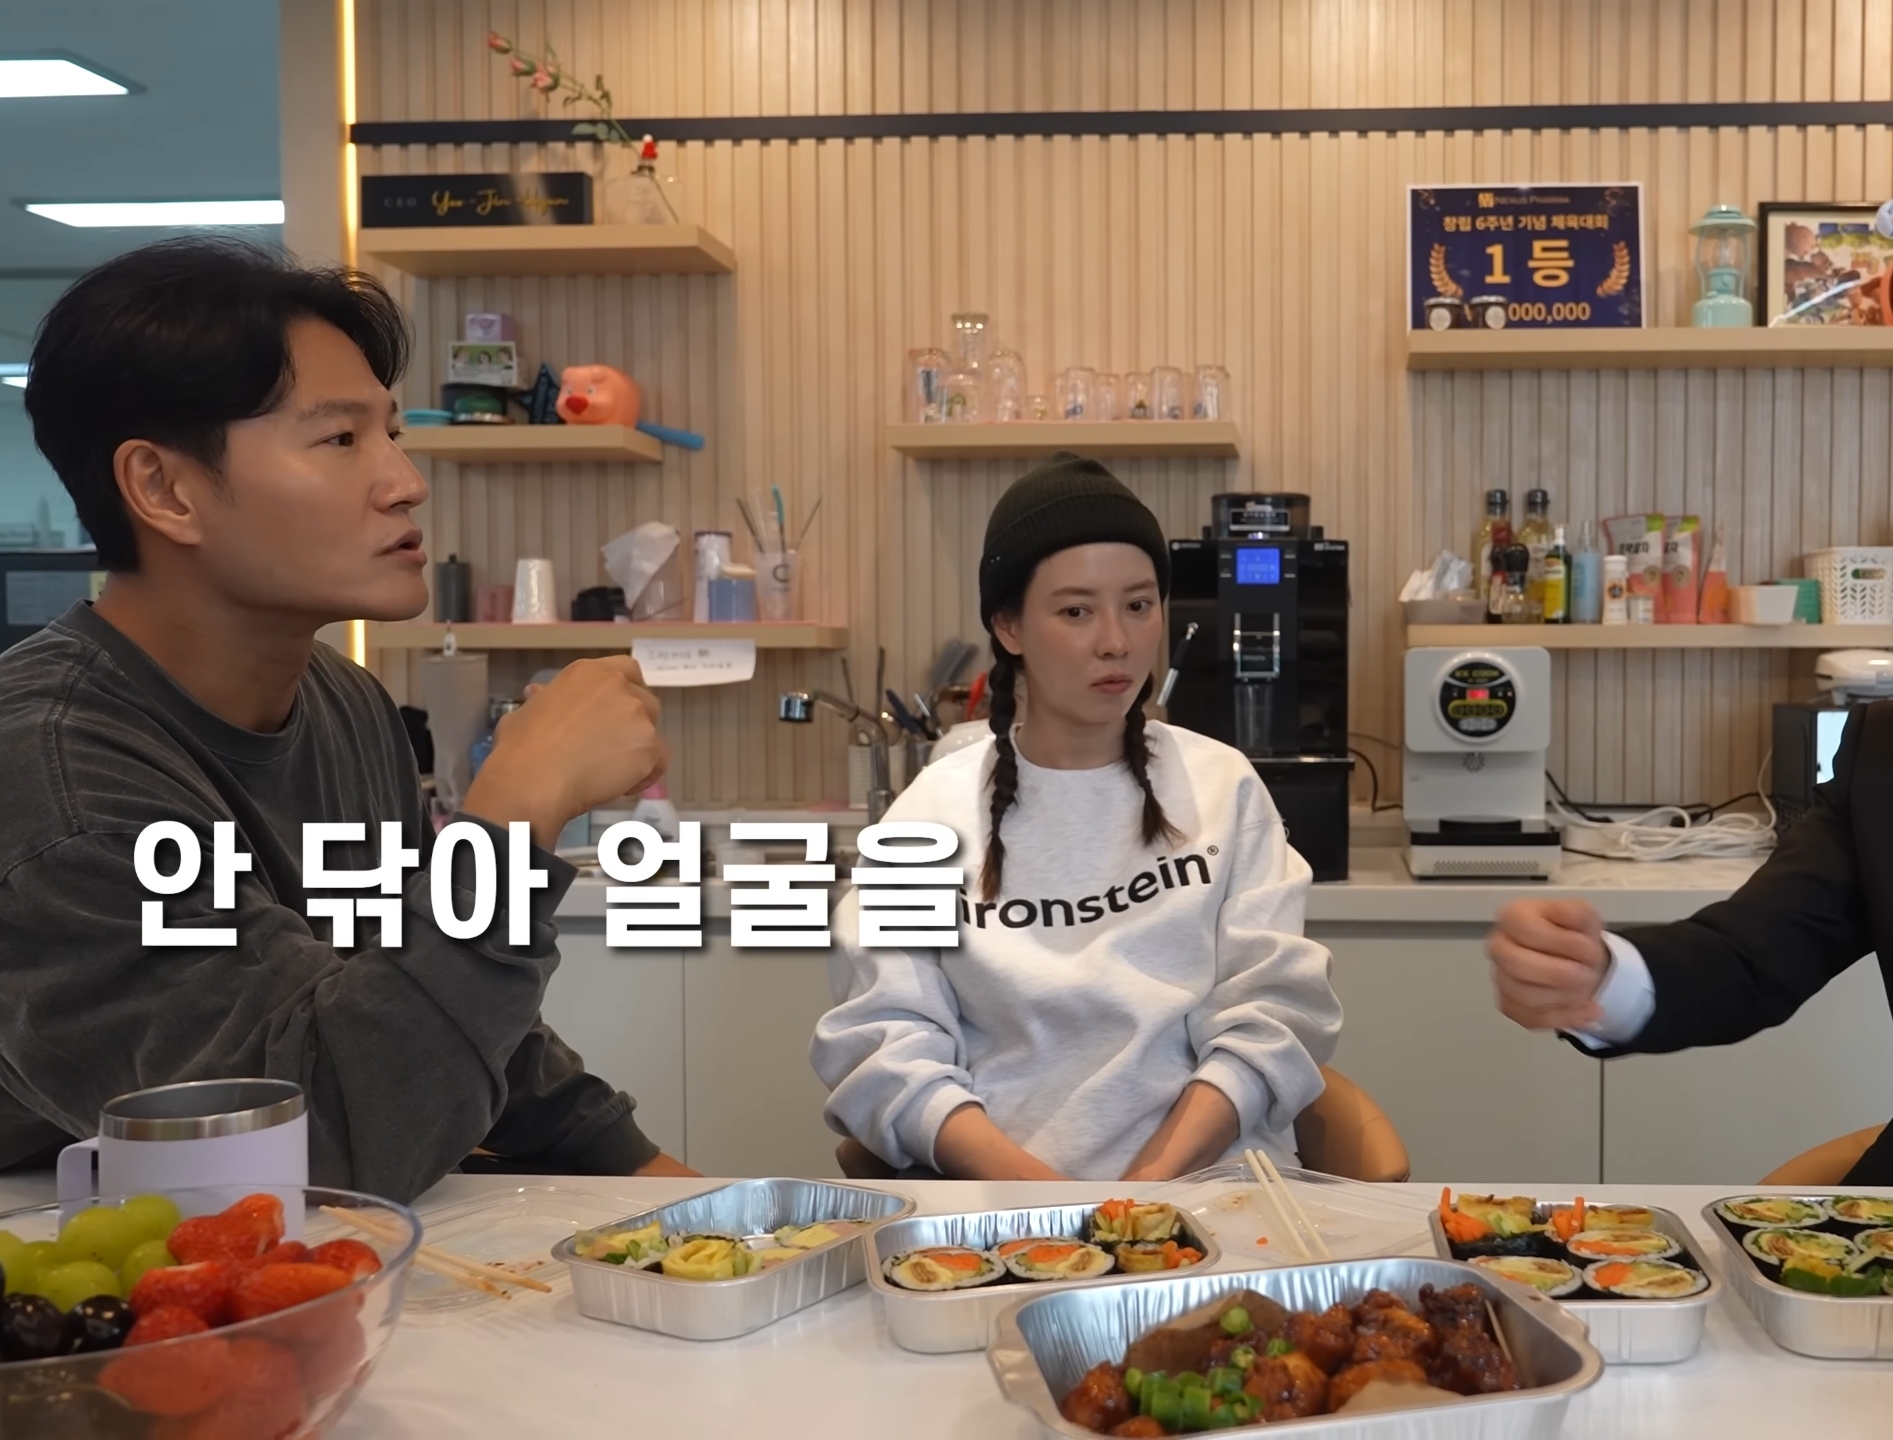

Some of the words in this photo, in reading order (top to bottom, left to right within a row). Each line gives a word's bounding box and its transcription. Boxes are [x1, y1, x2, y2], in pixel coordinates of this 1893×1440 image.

[1443, 215, 1472, 232] 창립
[1475, 215, 1514, 231] 6주년
[1518, 214, 1547, 231] 기념
[1551, 214, 1609, 230] 체육대회
[1485, 244, 1511, 284] 1
[1527, 239, 1575, 288] 등
[1464, 302, 1591, 324] 000,000
[960, 853, 1212, 929] ironstein
